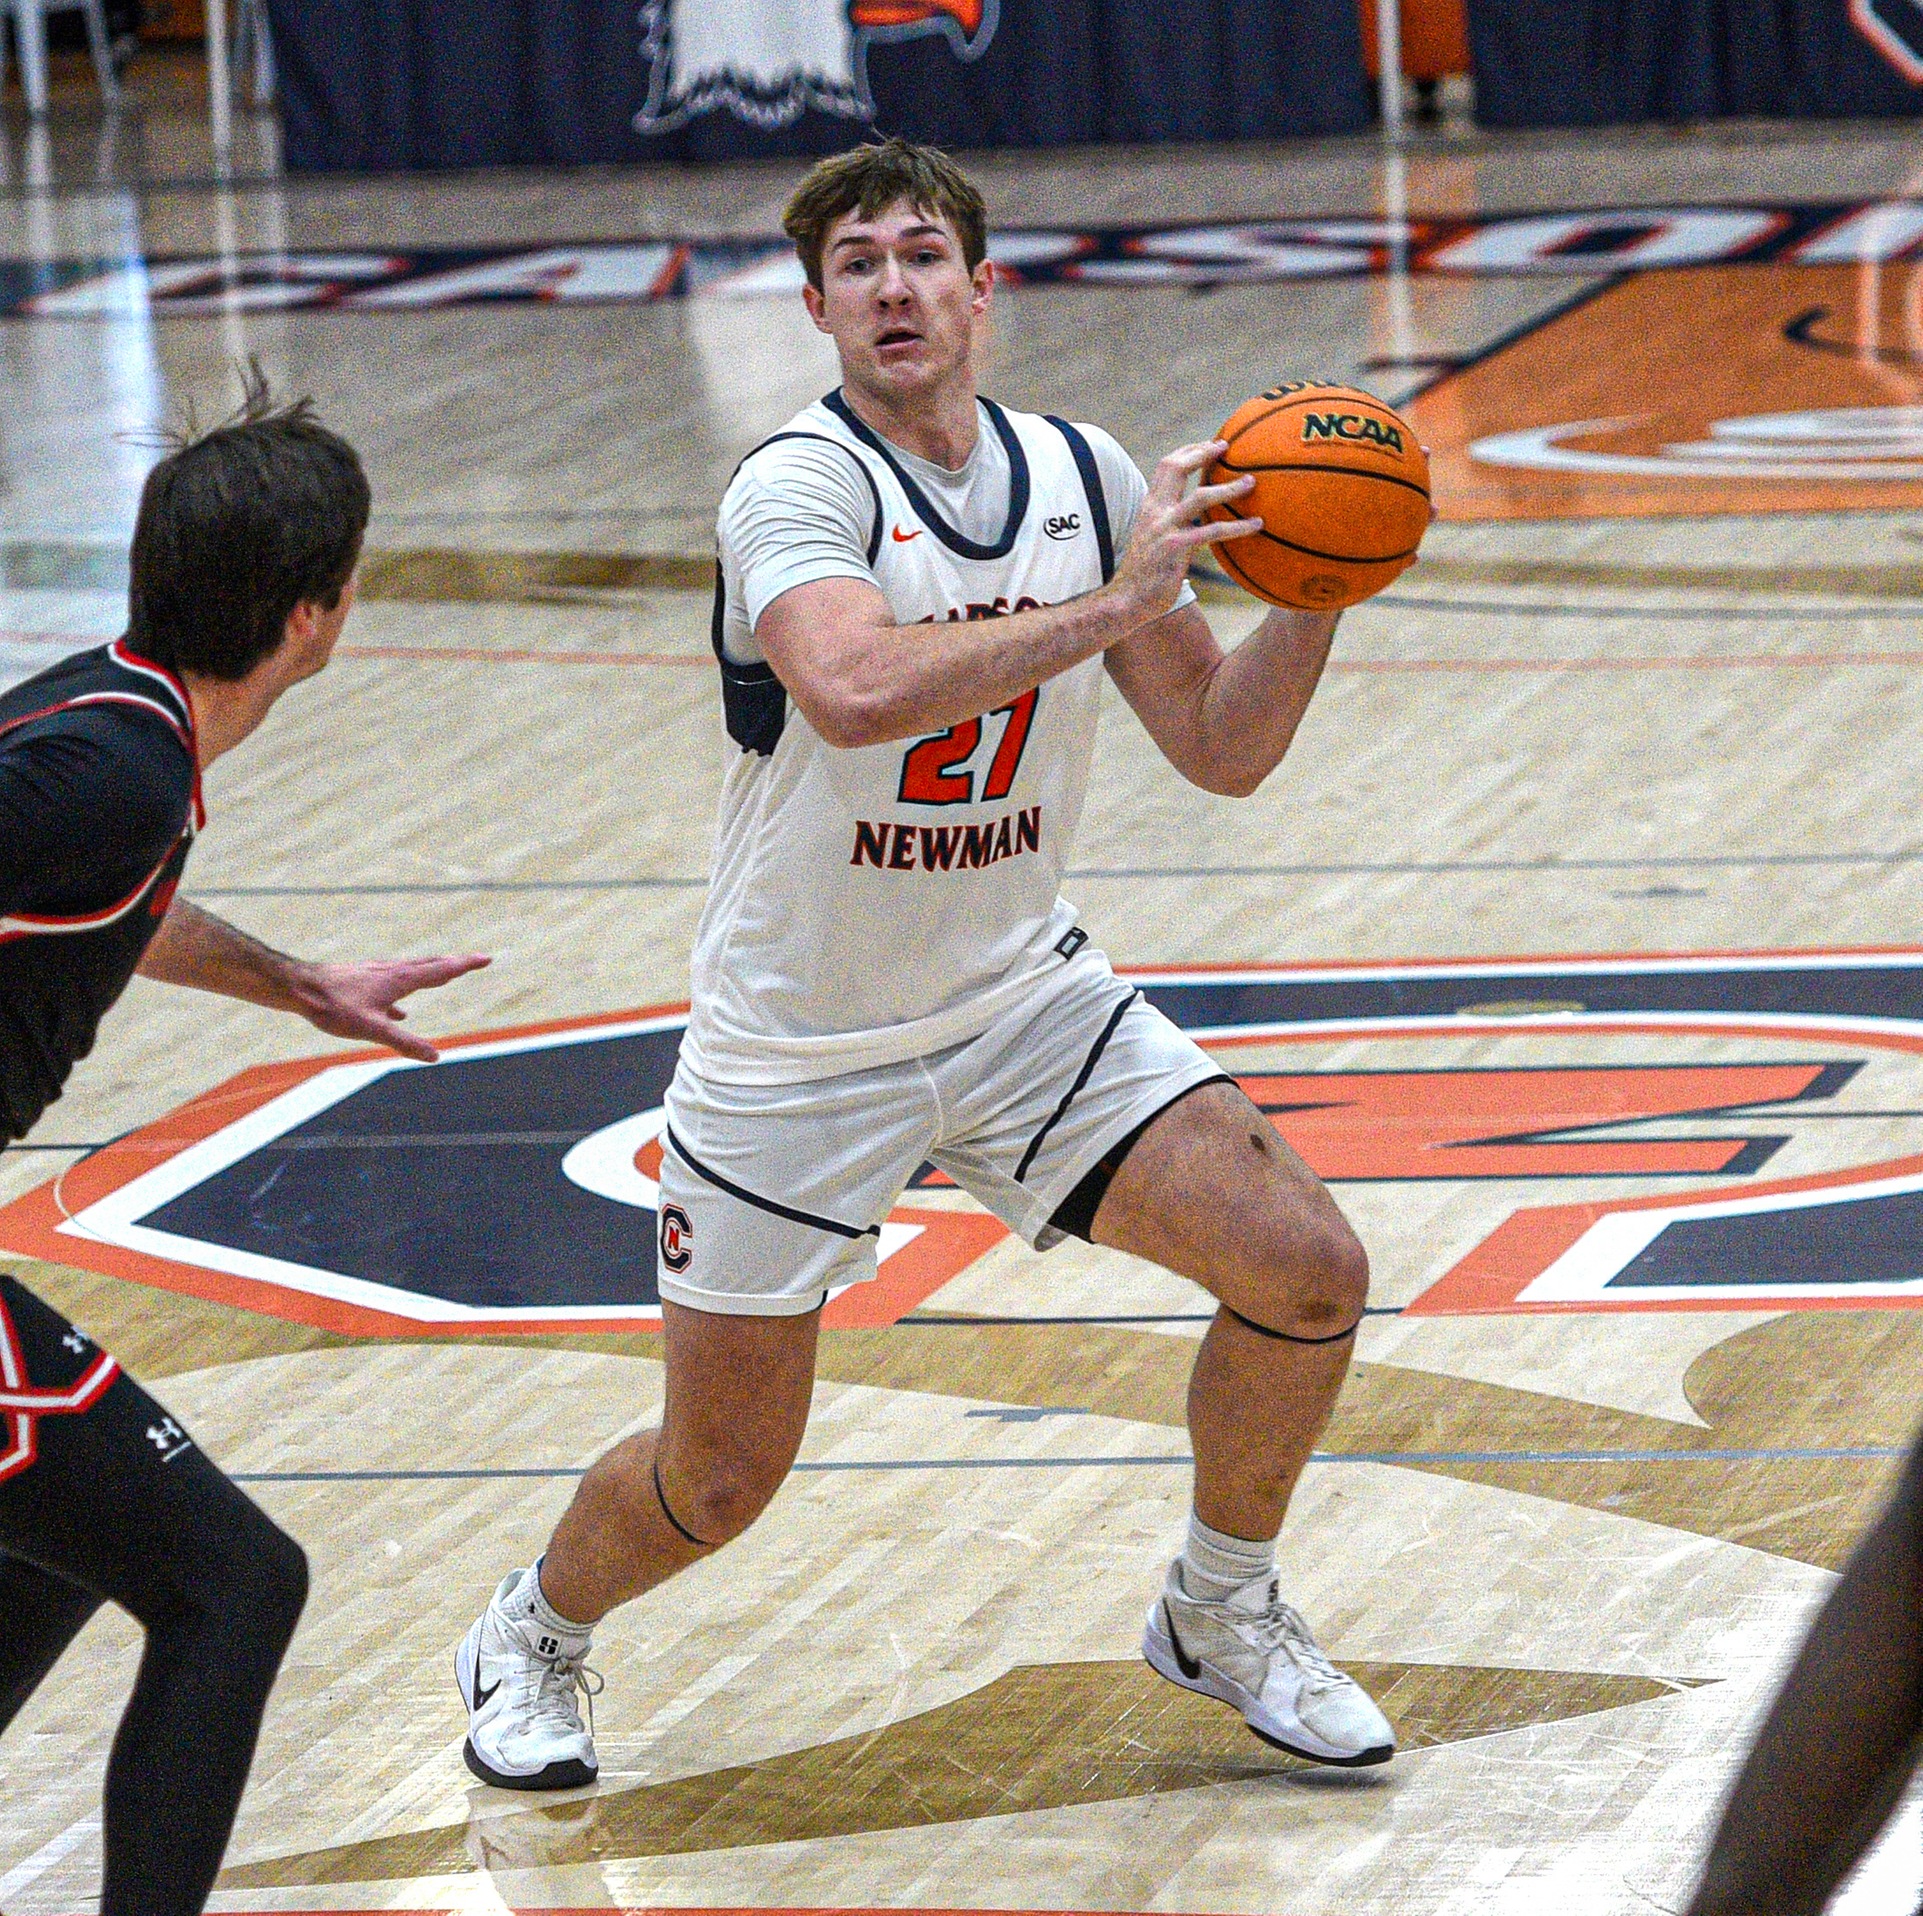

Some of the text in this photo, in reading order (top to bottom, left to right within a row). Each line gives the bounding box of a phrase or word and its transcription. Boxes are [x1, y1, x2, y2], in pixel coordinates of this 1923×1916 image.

[1303, 411, 1403, 454] NCAA
[1047, 513, 1081, 534] SAC
[896, 687, 1040, 804] 27
[850, 806, 1041, 872] NEWMAN
